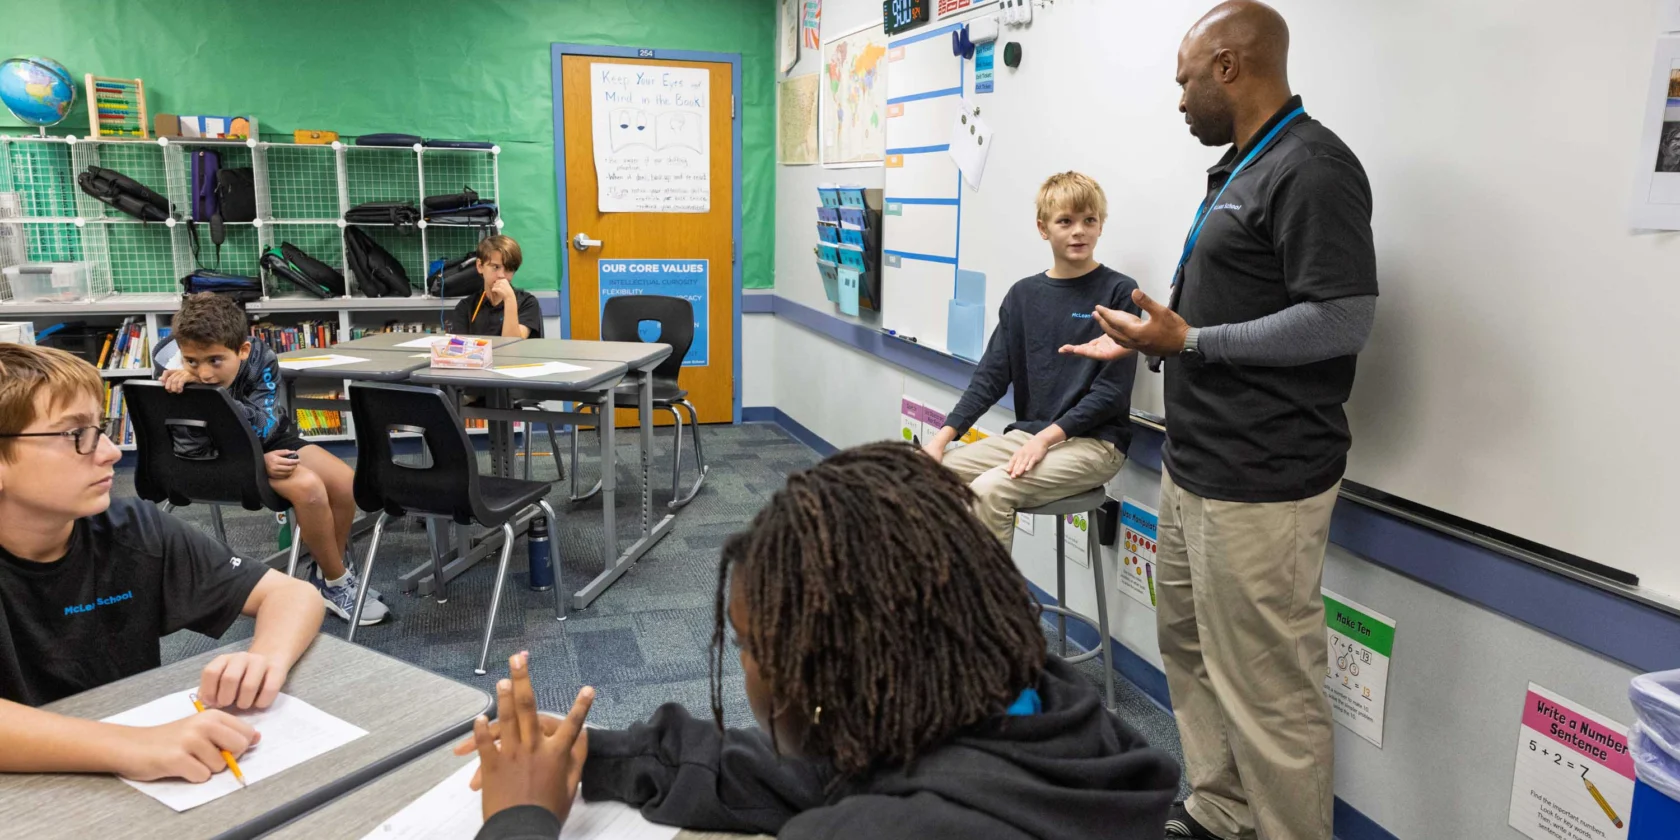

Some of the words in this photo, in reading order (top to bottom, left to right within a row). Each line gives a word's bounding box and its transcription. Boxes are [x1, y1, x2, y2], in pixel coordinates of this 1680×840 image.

[640, 49, 653, 57] 254
[602, 70, 629, 91] Keep
[636, 72, 655, 85] Your
[662, 73, 684, 92] Eyes
[605, 91, 633, 104] Mind
[642, 95, 650, 105] in
[656, 93, 671, 106] the
[602, 264, 627, 273] OUR
[629, 264, 659, 273] CORE
[661, 264, 704, 273] VALUES
[1132, 513, 1157, 532] Manipulati
[97, 590, 133, 606] School
[1336, 611, 1355, 629] Make
[1357, 621, 1371, 637] Ten
[1334, 636, 1339, 646] 7
[1347, 643, 1353, 653] 6
[1537, 700, 1567, 724] Write
[1569, 719, 1577, 730] a
[1580, 721, 1629, 755] Number
[1550, 723, 1607, 761] Sentence
[1529, 739, 1537, 751] 5
[1554, 753, 1562, 765] 2
[1580, 764, 1590, 779] 7
[1530, 789, 1542, 800] Find
[1543, 797, 1552, 807] the
[1552, 803, 1579, 822] important
[1580, 819, 1607, 839] numbers.
[1537, 811, 1552, 826] Then,
[1553, 822, 1567, 834] write
[1540, 804, 1554, 817] Look
[1554, 812, 1563, 822] for
[1563, 818, 1573, 829] key
[1574, 826, 1593, 840] words.
[1538, 823, 1563, 840] sentence
